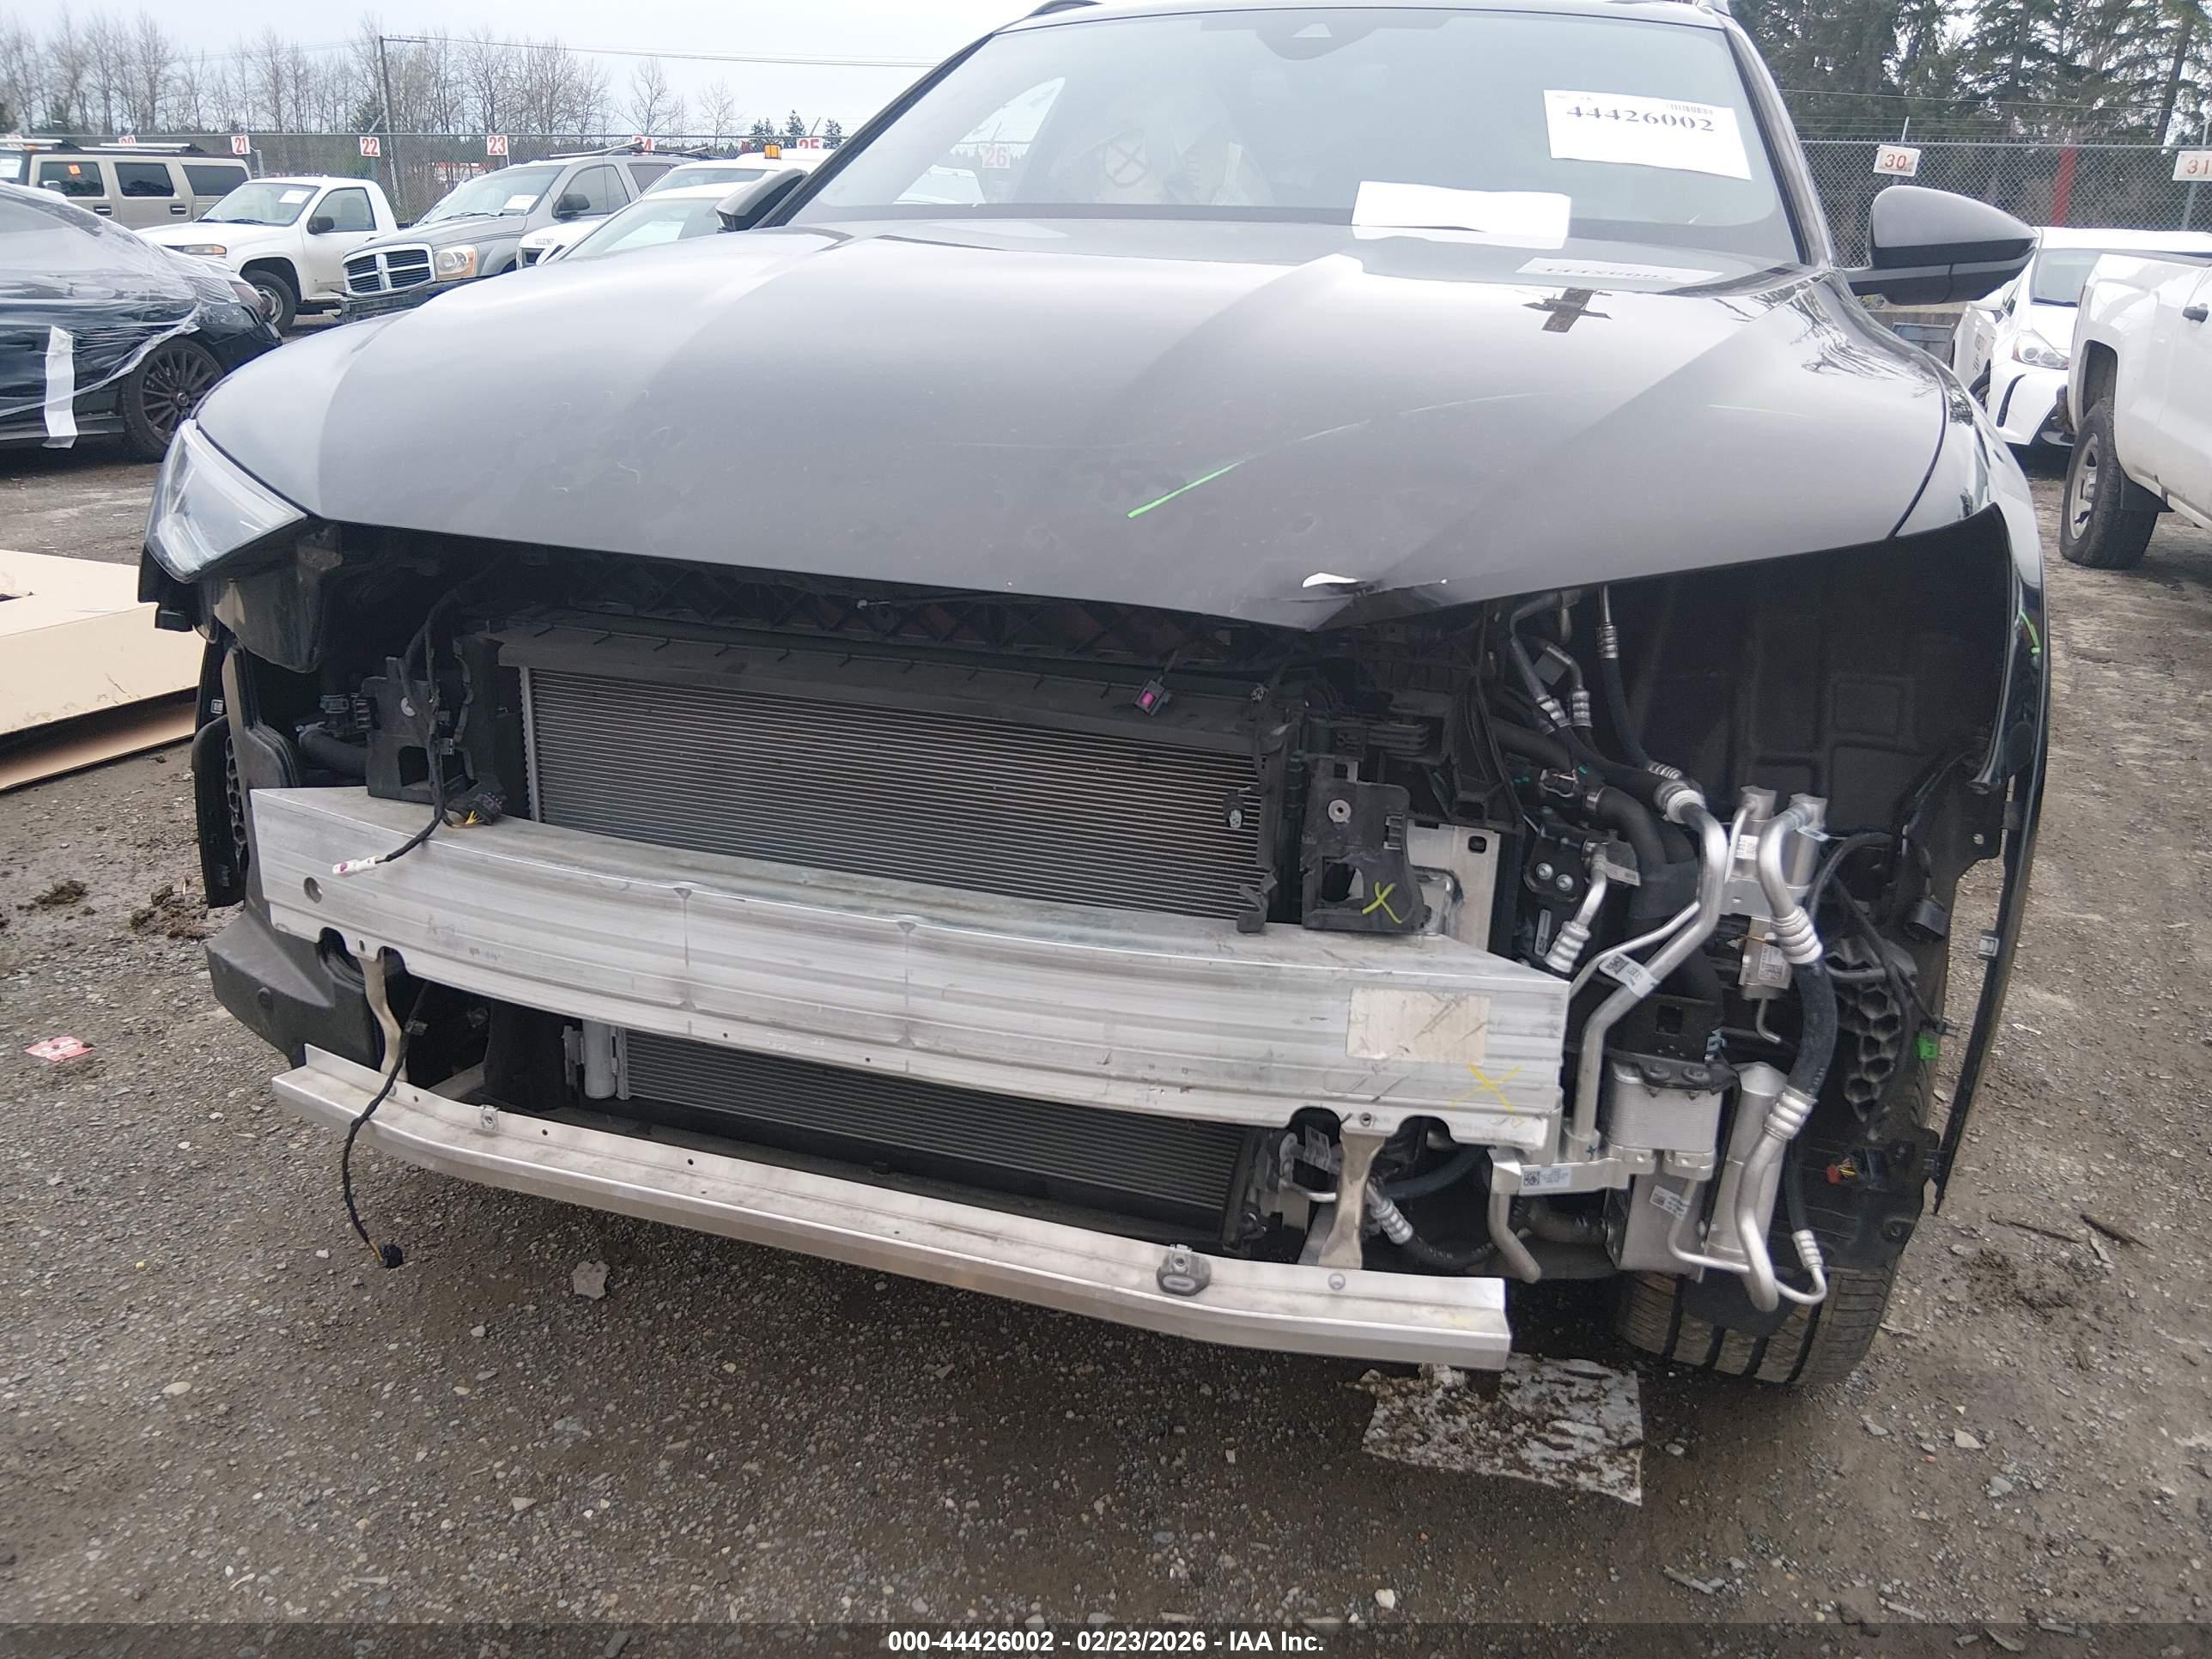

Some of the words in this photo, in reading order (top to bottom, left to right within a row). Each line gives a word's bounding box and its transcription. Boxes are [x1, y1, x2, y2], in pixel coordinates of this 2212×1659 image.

[1565, 106, 1715, 132] 44426002
[235, 137, 249, 154] 21
[362, 137, 379, 155] 22
[488, 137, 506, 155] 23
[985, 147, 1008, 167] 26
[1884, 154, 1908, 170] 30
[2187, 159, 2210, 175] 31
